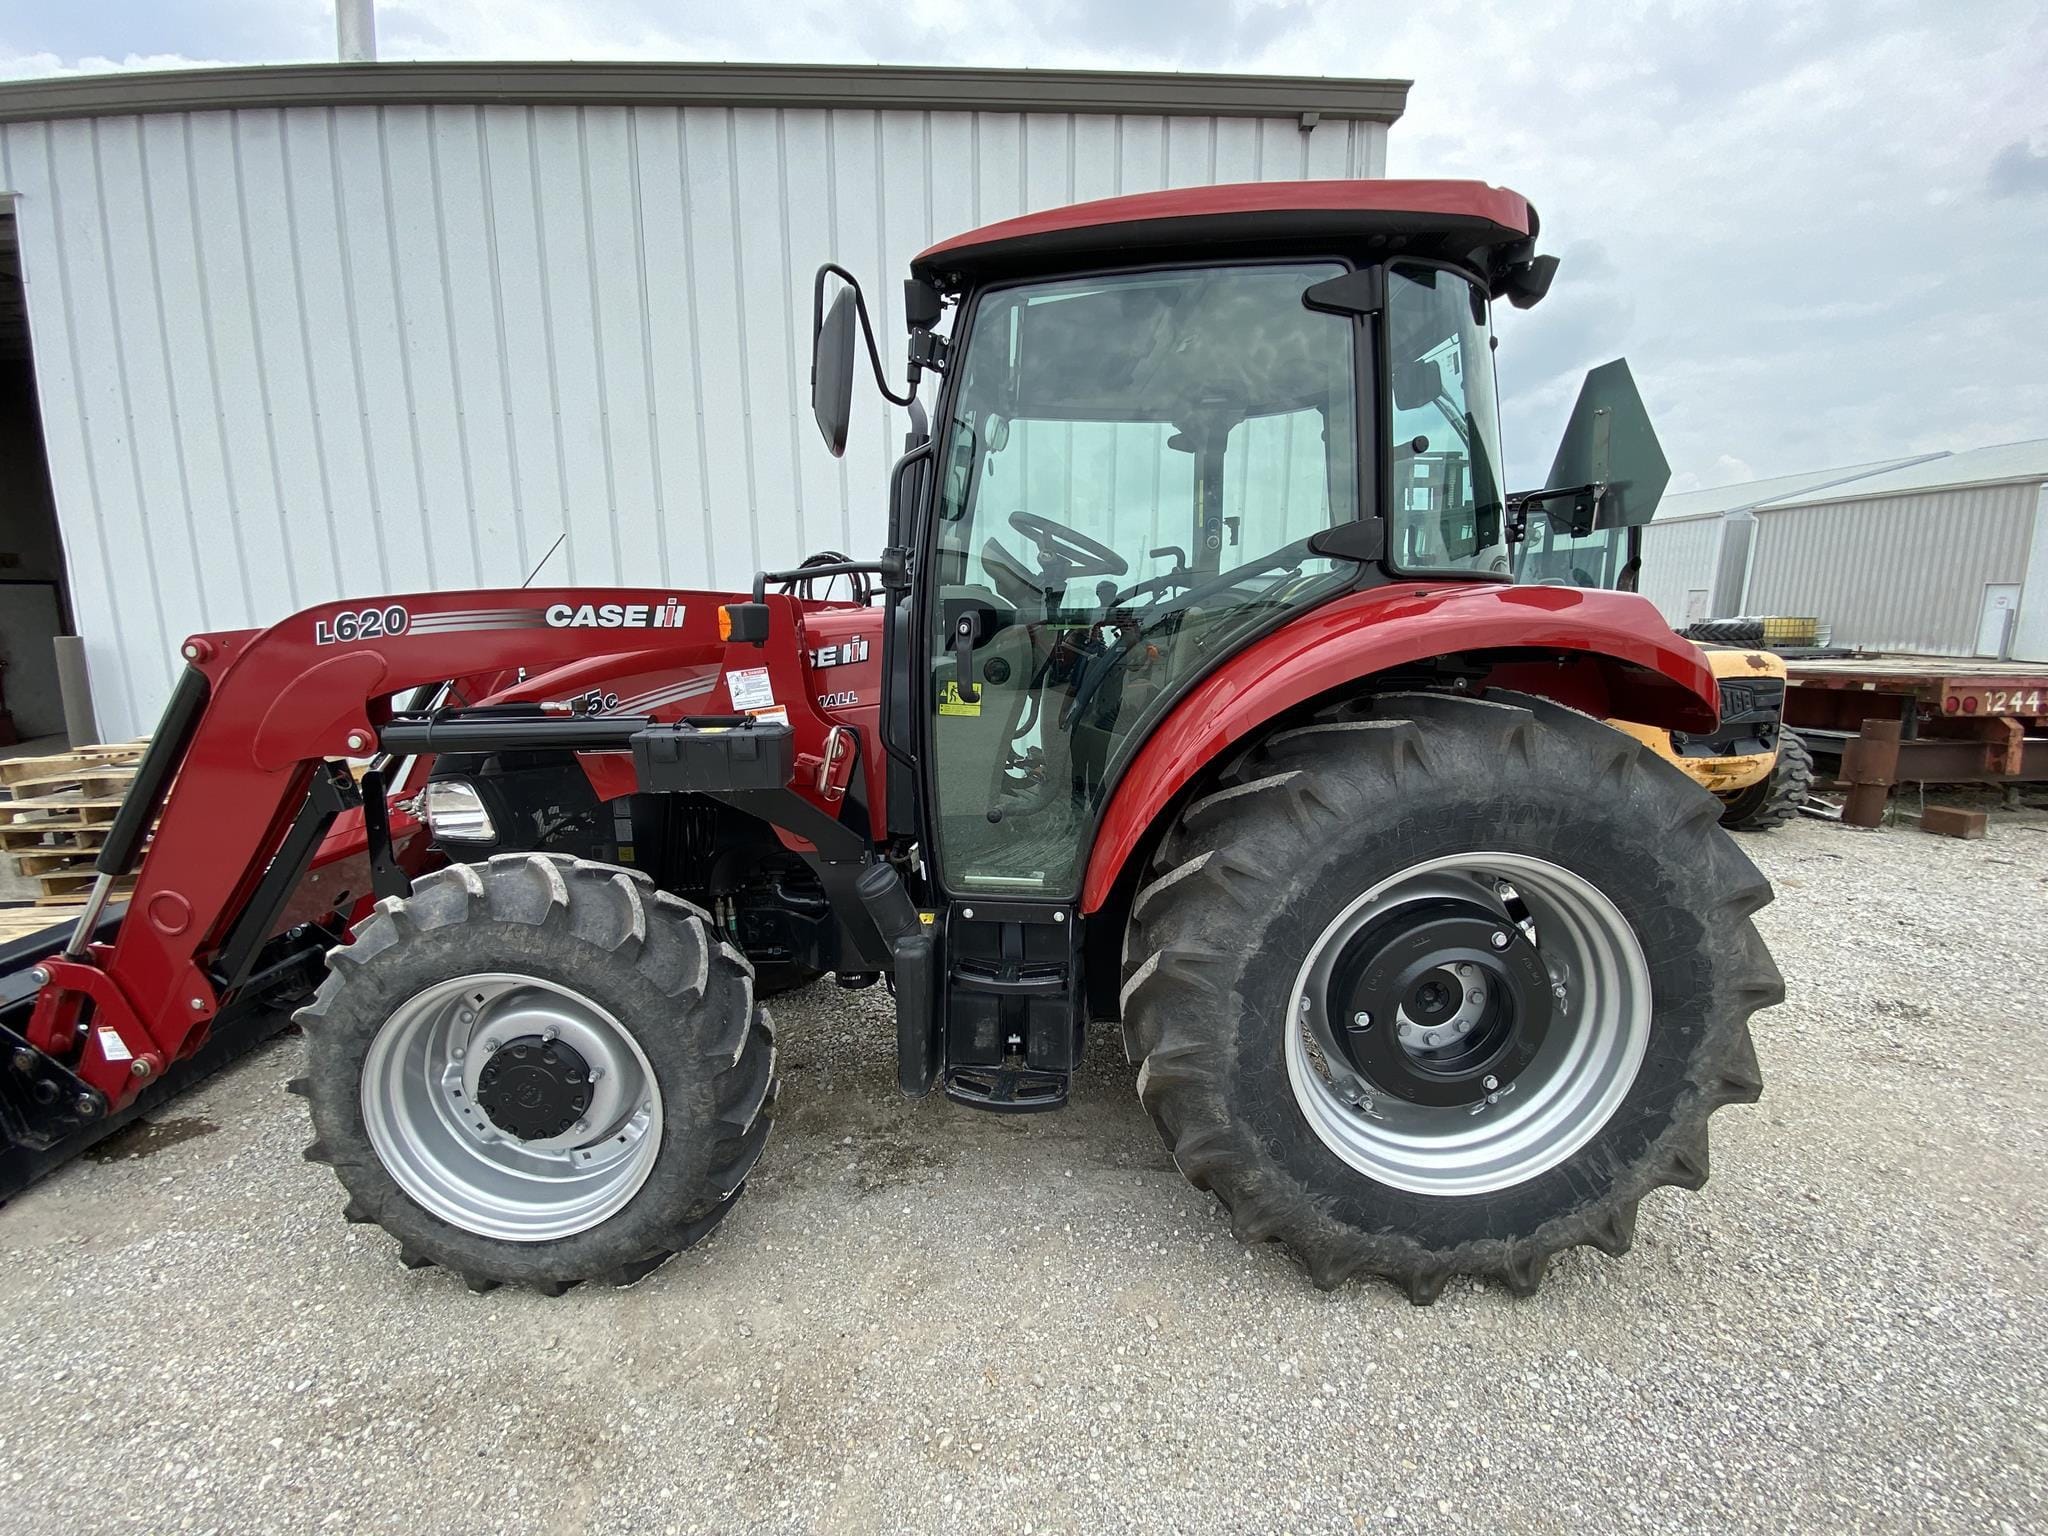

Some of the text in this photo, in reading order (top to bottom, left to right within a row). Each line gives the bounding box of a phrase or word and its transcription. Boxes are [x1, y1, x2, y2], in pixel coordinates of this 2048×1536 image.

[316, 605, 408, 646] L620
[545, 604, 648, 628] CASE
[1985, 690, 2040, 713] 1244
